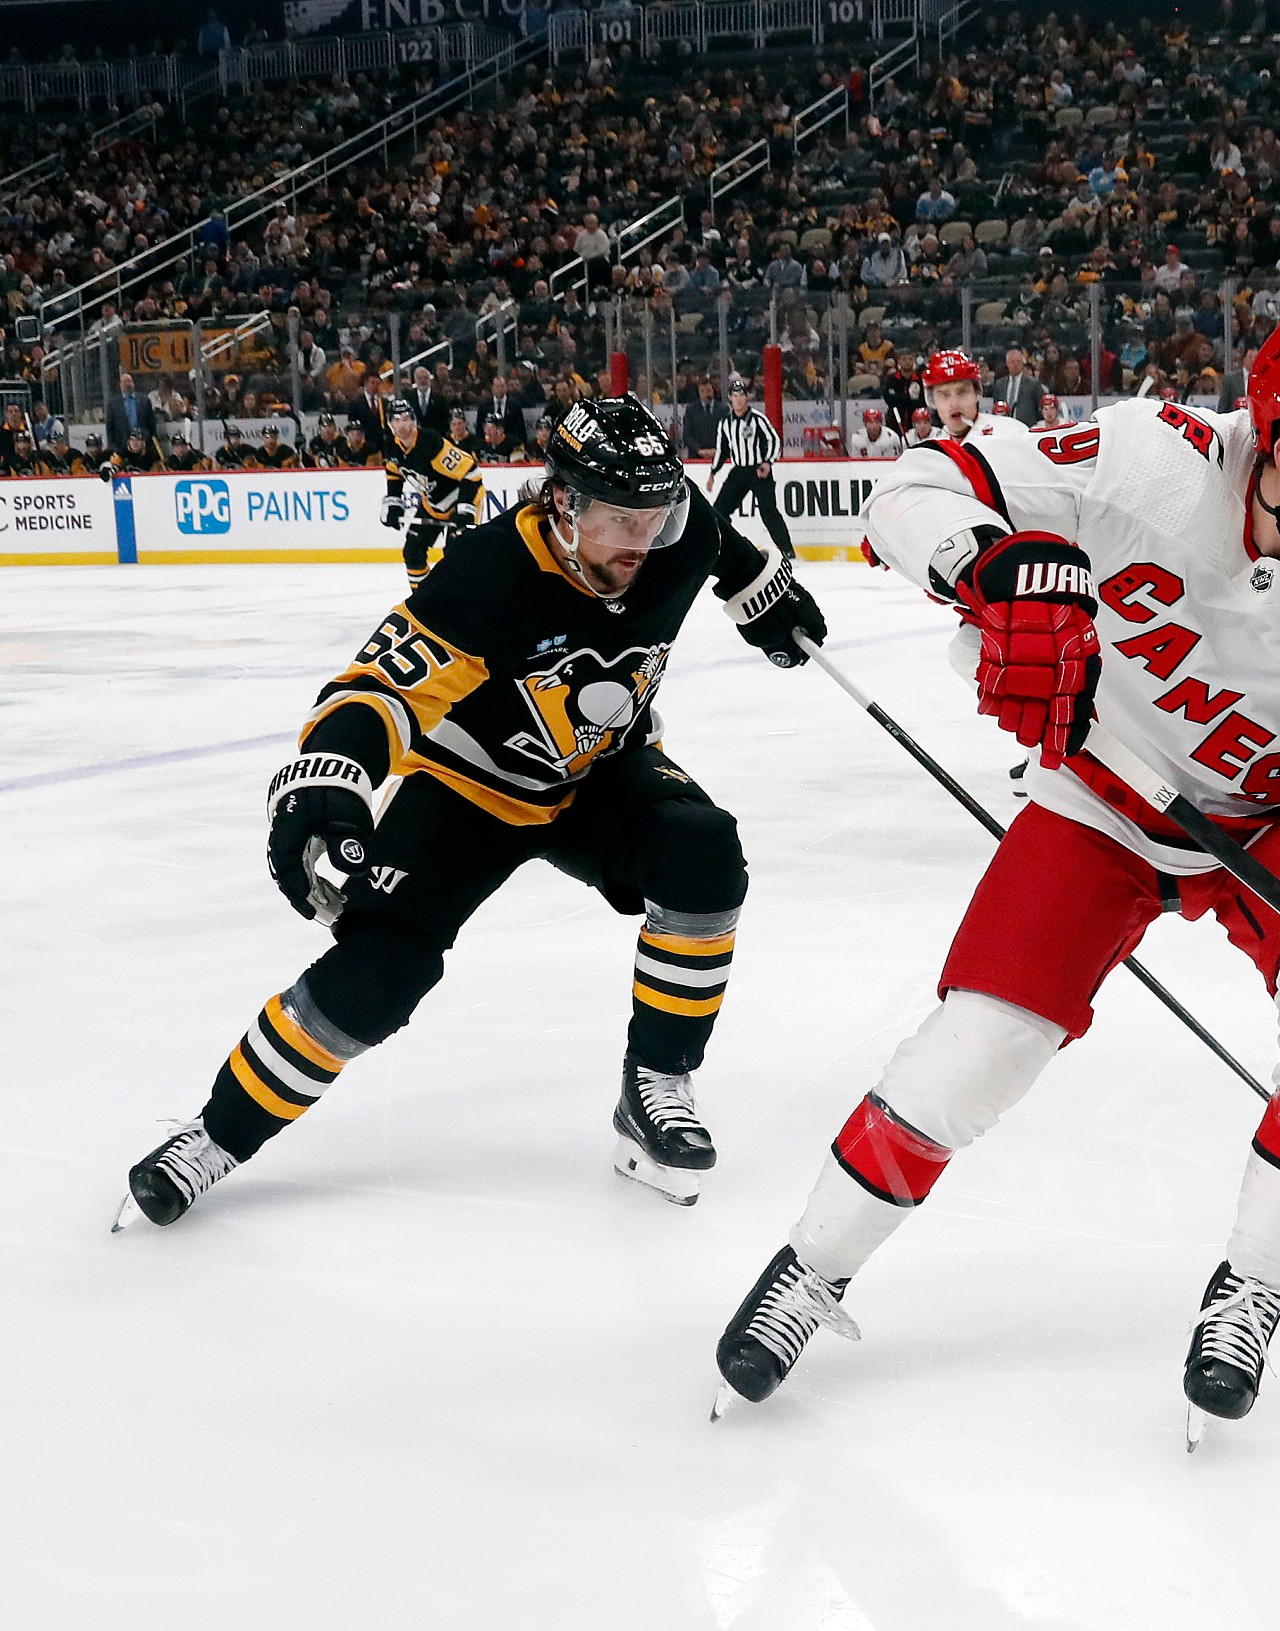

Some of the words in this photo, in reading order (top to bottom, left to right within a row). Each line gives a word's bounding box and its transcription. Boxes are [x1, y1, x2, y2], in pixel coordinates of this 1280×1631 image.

[600, 20, 632, 42] 101
[399, 41, 433, 62] 122
[634, 432, 665, 457] 65
[441, 449, 462, 471] 28
[639, 480, 674, 492] CCM
[13, 495, 76, 510] SPORTS
[177, 484, 229, 530] PPG
[247, 491, 350, 522] PAINTS
[15, 515, 93, 531] MEDICINE
[352, 609, 455, 690] 65
[268, 756, 362, 804] ARRIOR
